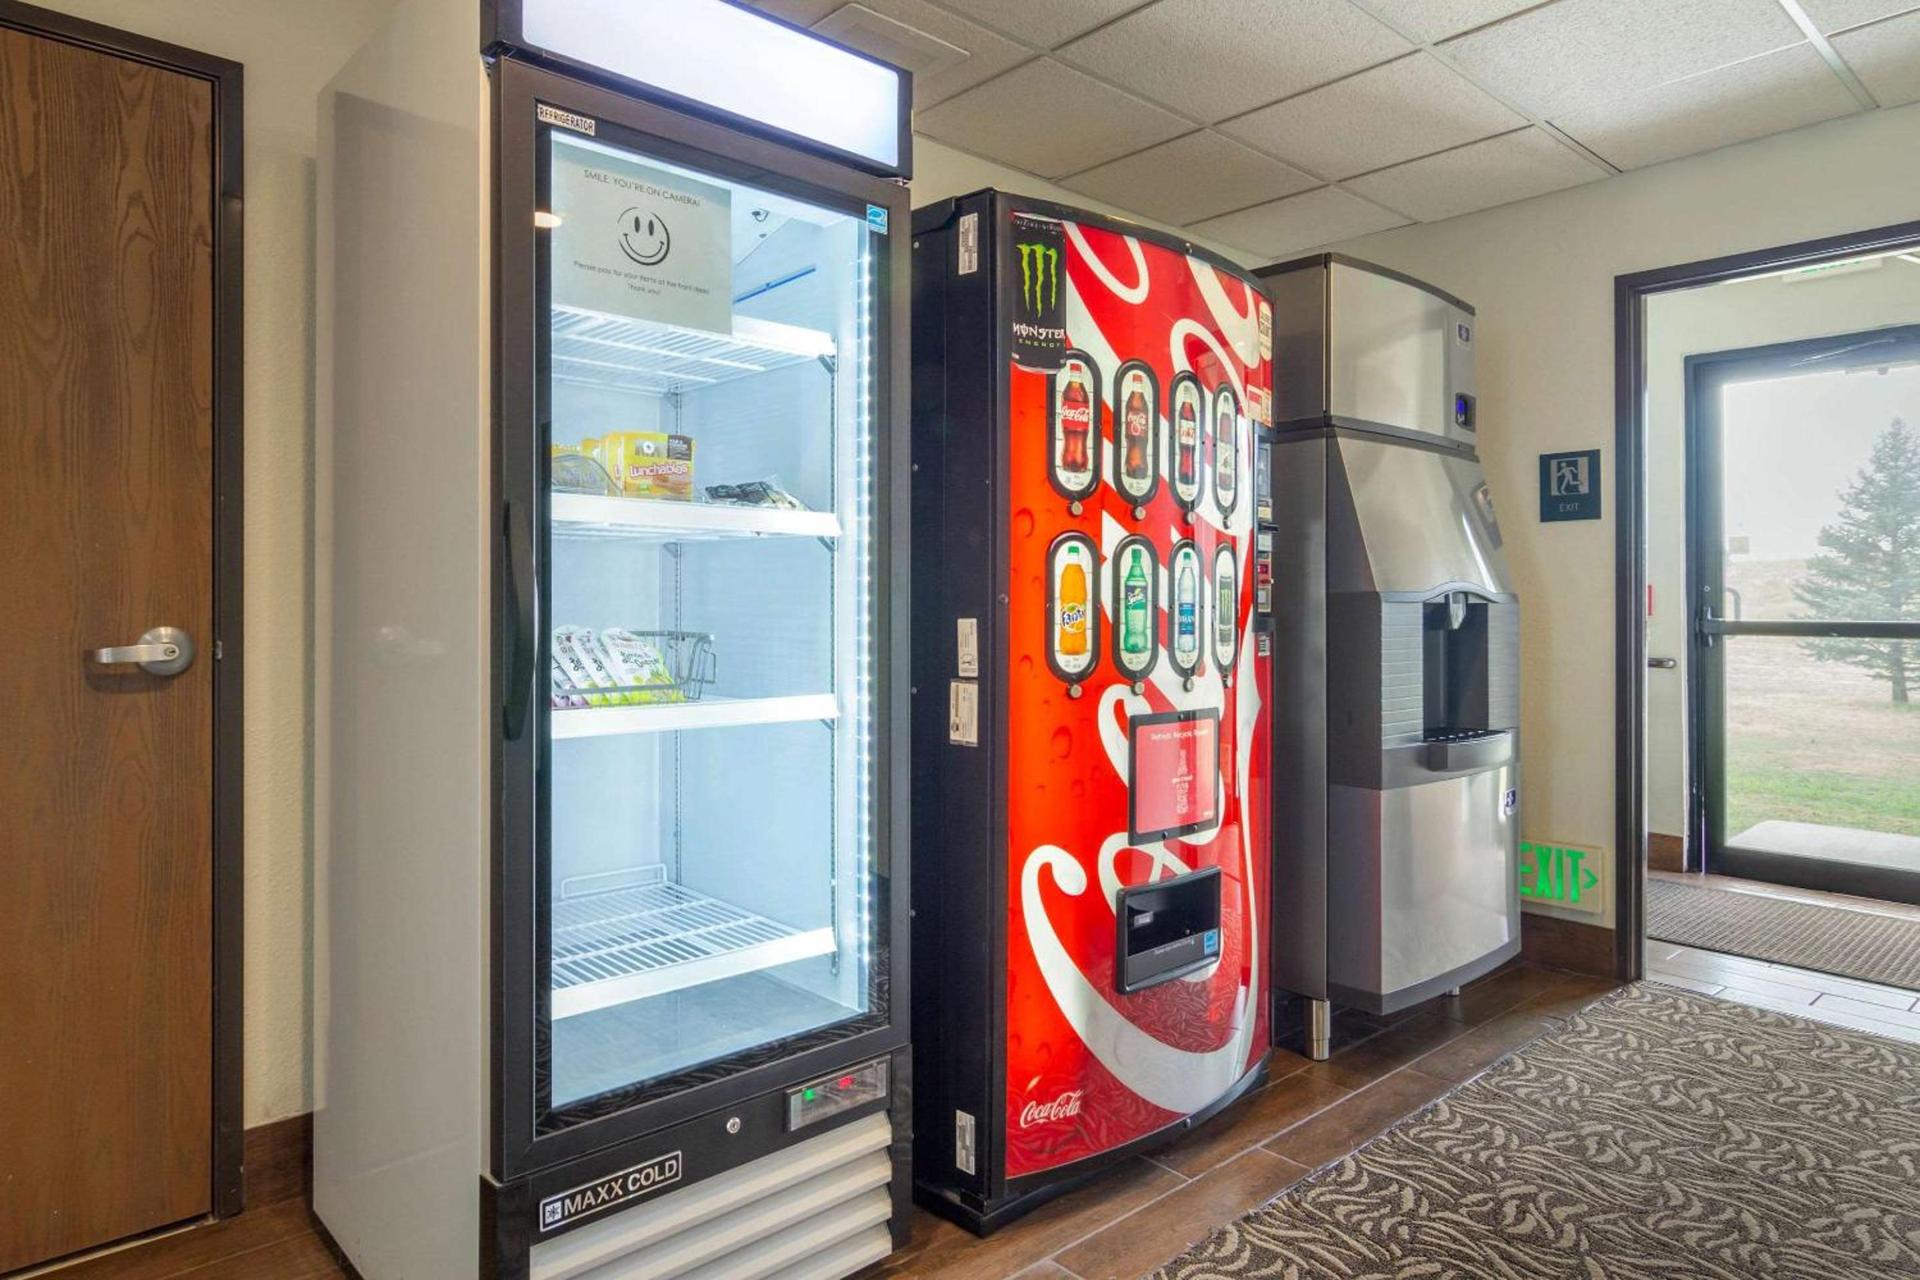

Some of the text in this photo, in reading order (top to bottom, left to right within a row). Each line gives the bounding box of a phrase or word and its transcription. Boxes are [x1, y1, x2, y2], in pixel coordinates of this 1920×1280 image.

[538, 106, 594, 133] REFRIGERATOR
[613, 177, 645, 193] YOU'RE
[646, 186, 660, 197] ON
[1013, 322, 1065, 340] MONSTER
[1559, 502, 1579, 512] EXIT
[1520, 842, 1587, 902] EXIT
[1020, 1089, 1086, 1128] Coca-Cola
[564, 1159, 678, 1217] MAXX COLD
